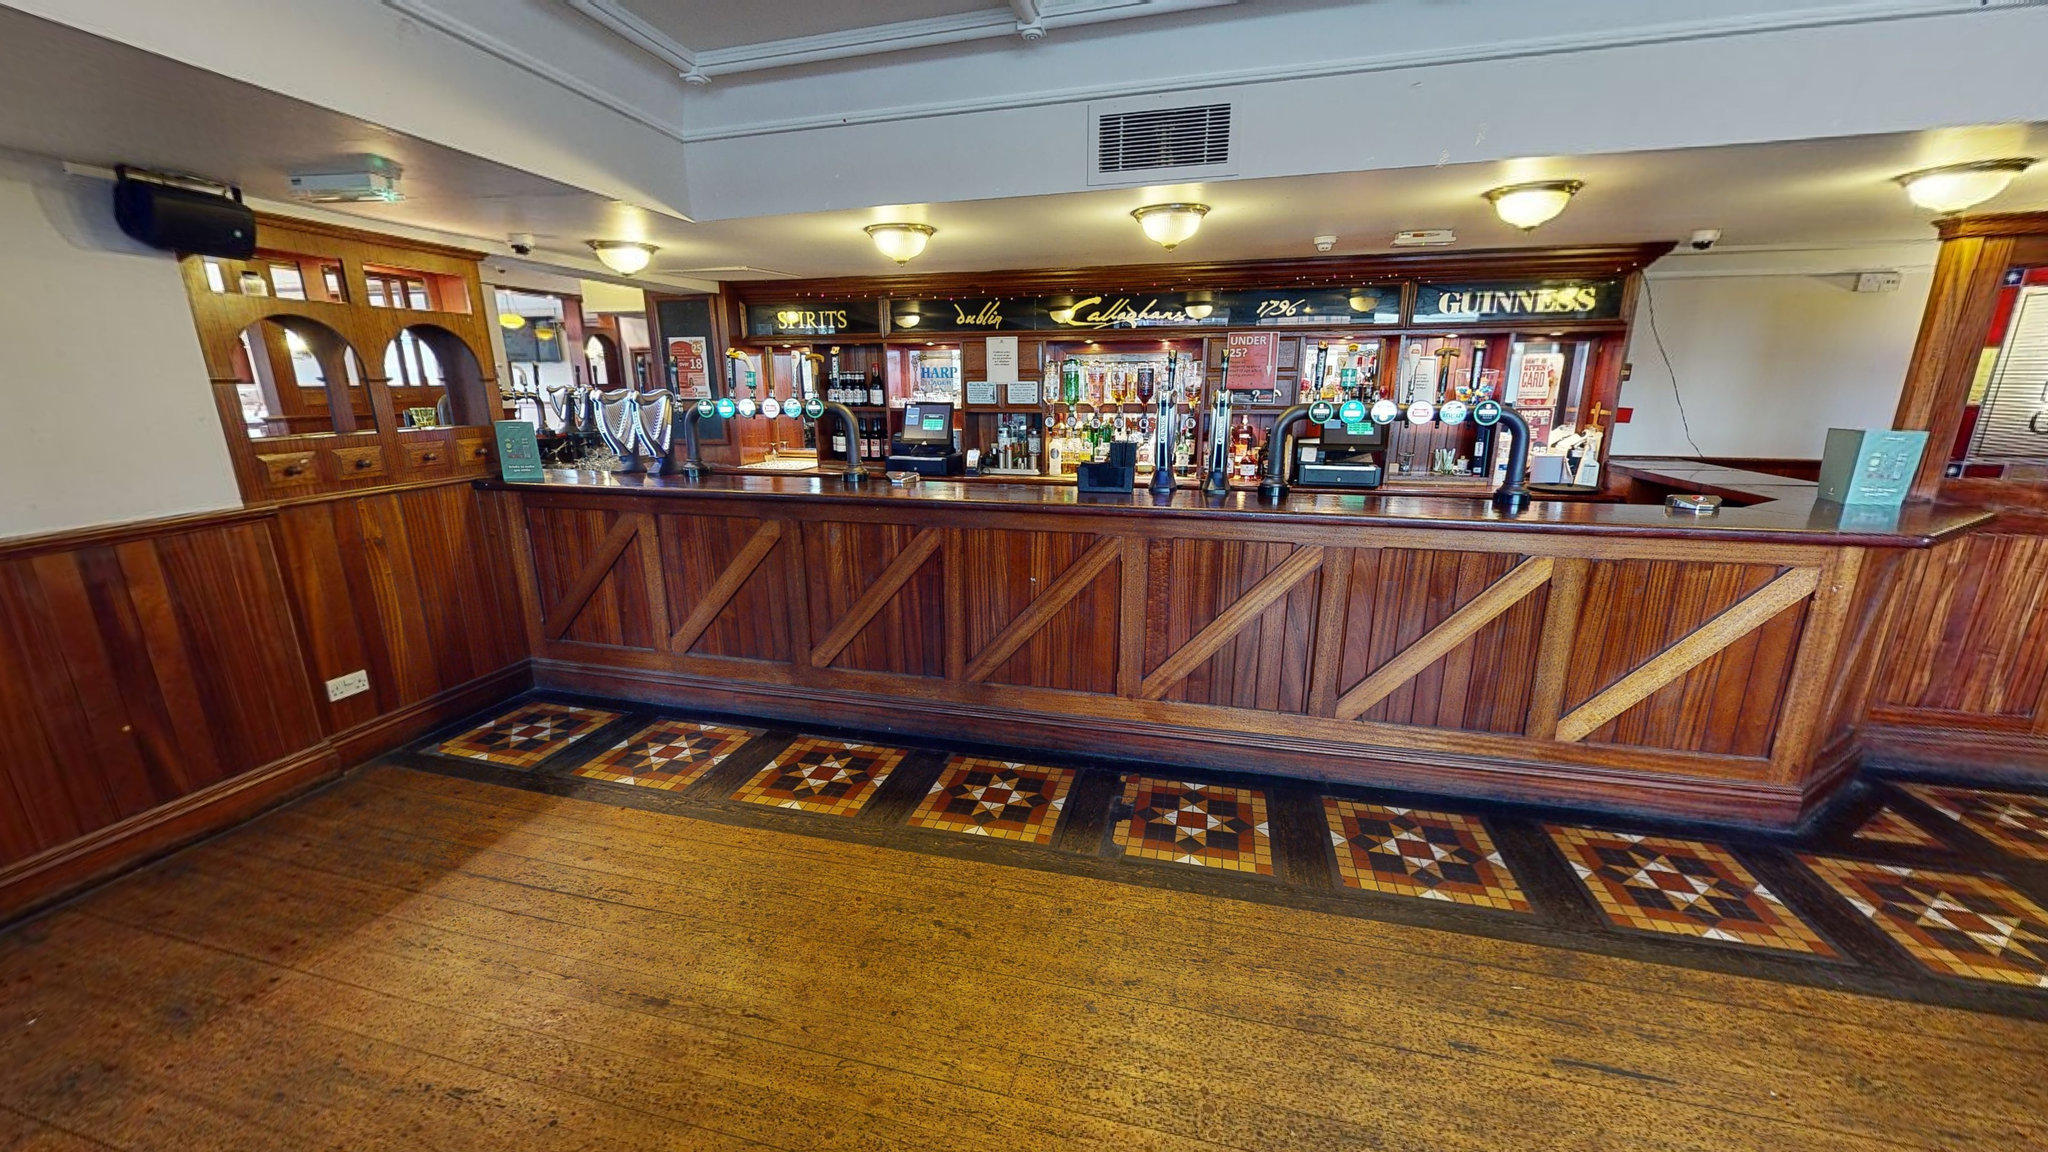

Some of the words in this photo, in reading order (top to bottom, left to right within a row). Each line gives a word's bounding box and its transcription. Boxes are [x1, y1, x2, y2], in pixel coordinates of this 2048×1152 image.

[1256, 298, 1306, 318] 1796
[1438, 287, 1597, 315] GUINNESS
[777, 310, 848, 329] SPIRITS
[1064, 296, 1189, 329] Callaghans
[1230, 336, 1267, 346] UNDER
[1229, 347, 1248, 358] 25?
[690, 358, 703, 369] 18
[921, 366, 958, 379] HARP
[1521, 371, 1546, 388] CARD
